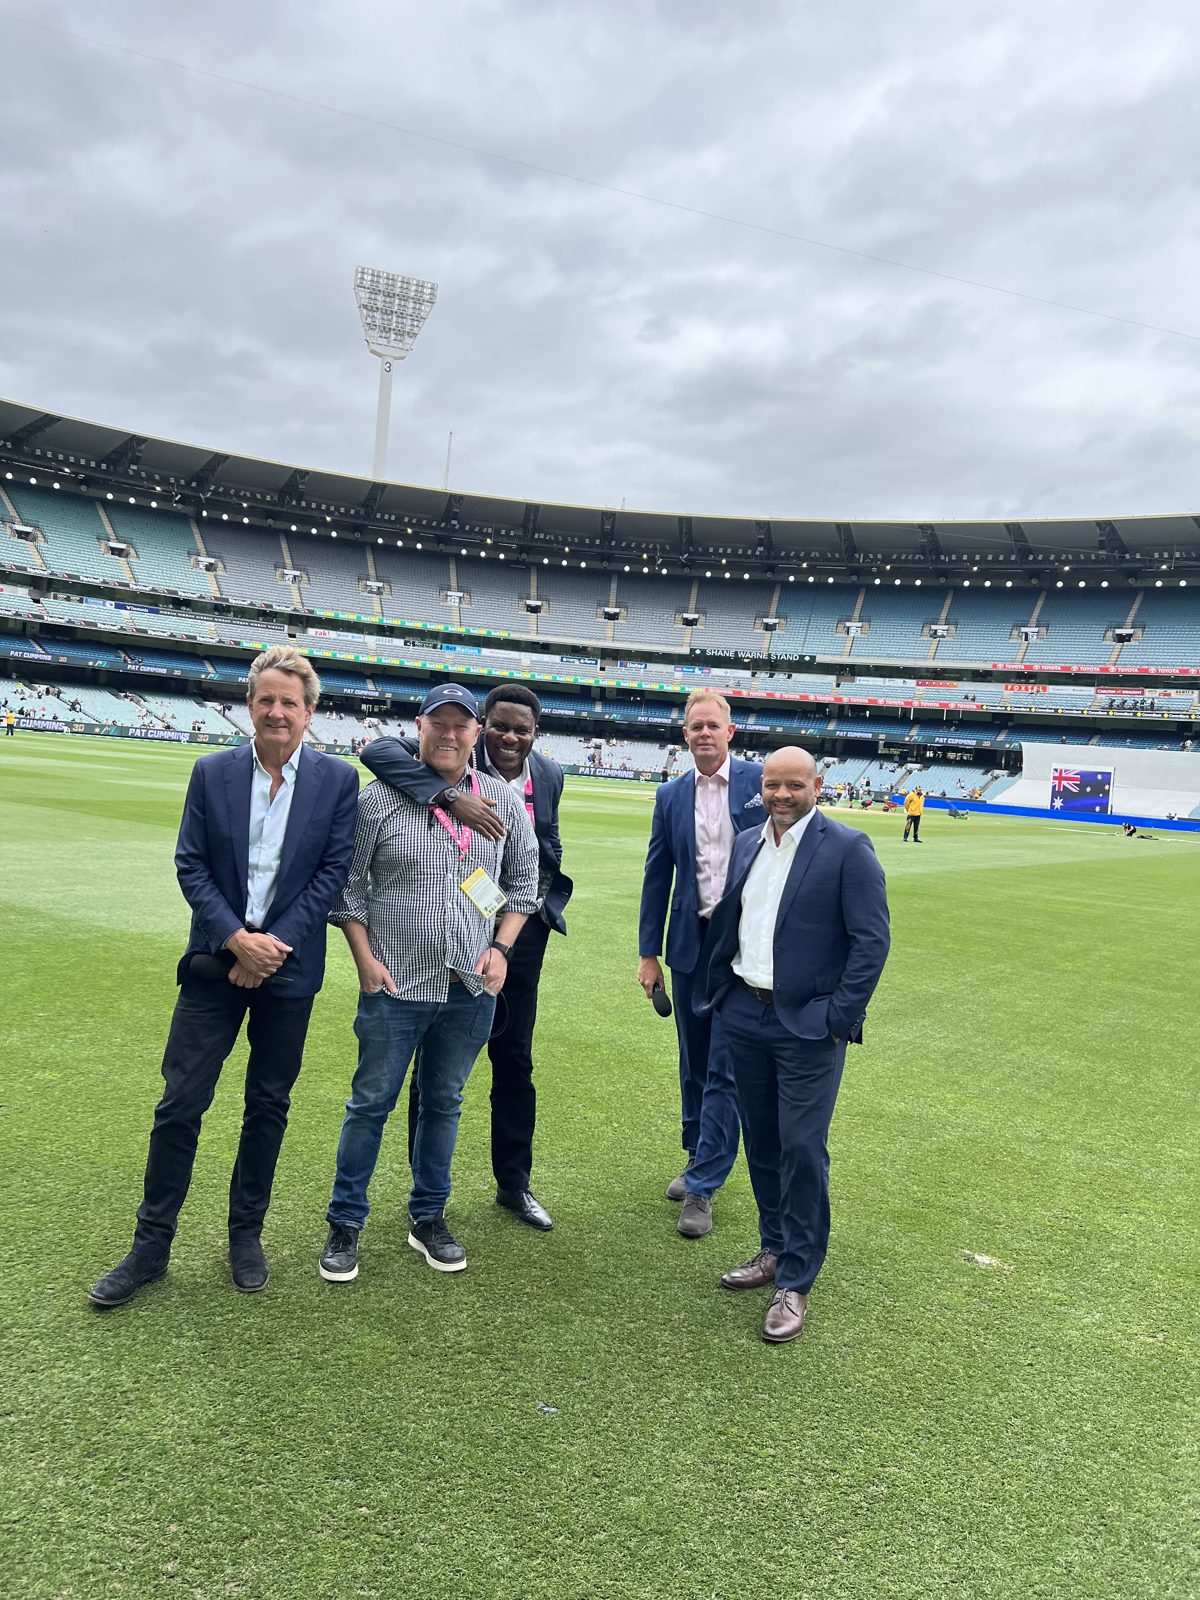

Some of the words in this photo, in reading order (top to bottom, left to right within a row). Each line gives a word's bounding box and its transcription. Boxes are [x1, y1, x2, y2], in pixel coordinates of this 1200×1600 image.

[384, 361, 392, 373] 3
[23, 652, 52, 661] CUMMINS
[706, 649, 735, 657] SHANE
[737, 651, 768, 659] WARNE
[770, 653, 799, 661] STAND
[140, 666, 167, 674] CUMMINS
[20, 719, 65, 730] CUMMINS
[128, 728, 147, 737] PAT
[147, 730, 190, 740] CUMMINS
[947, 738, 977, 746] CUMMINS
[596, 768, 635, 779] CUMMINS
